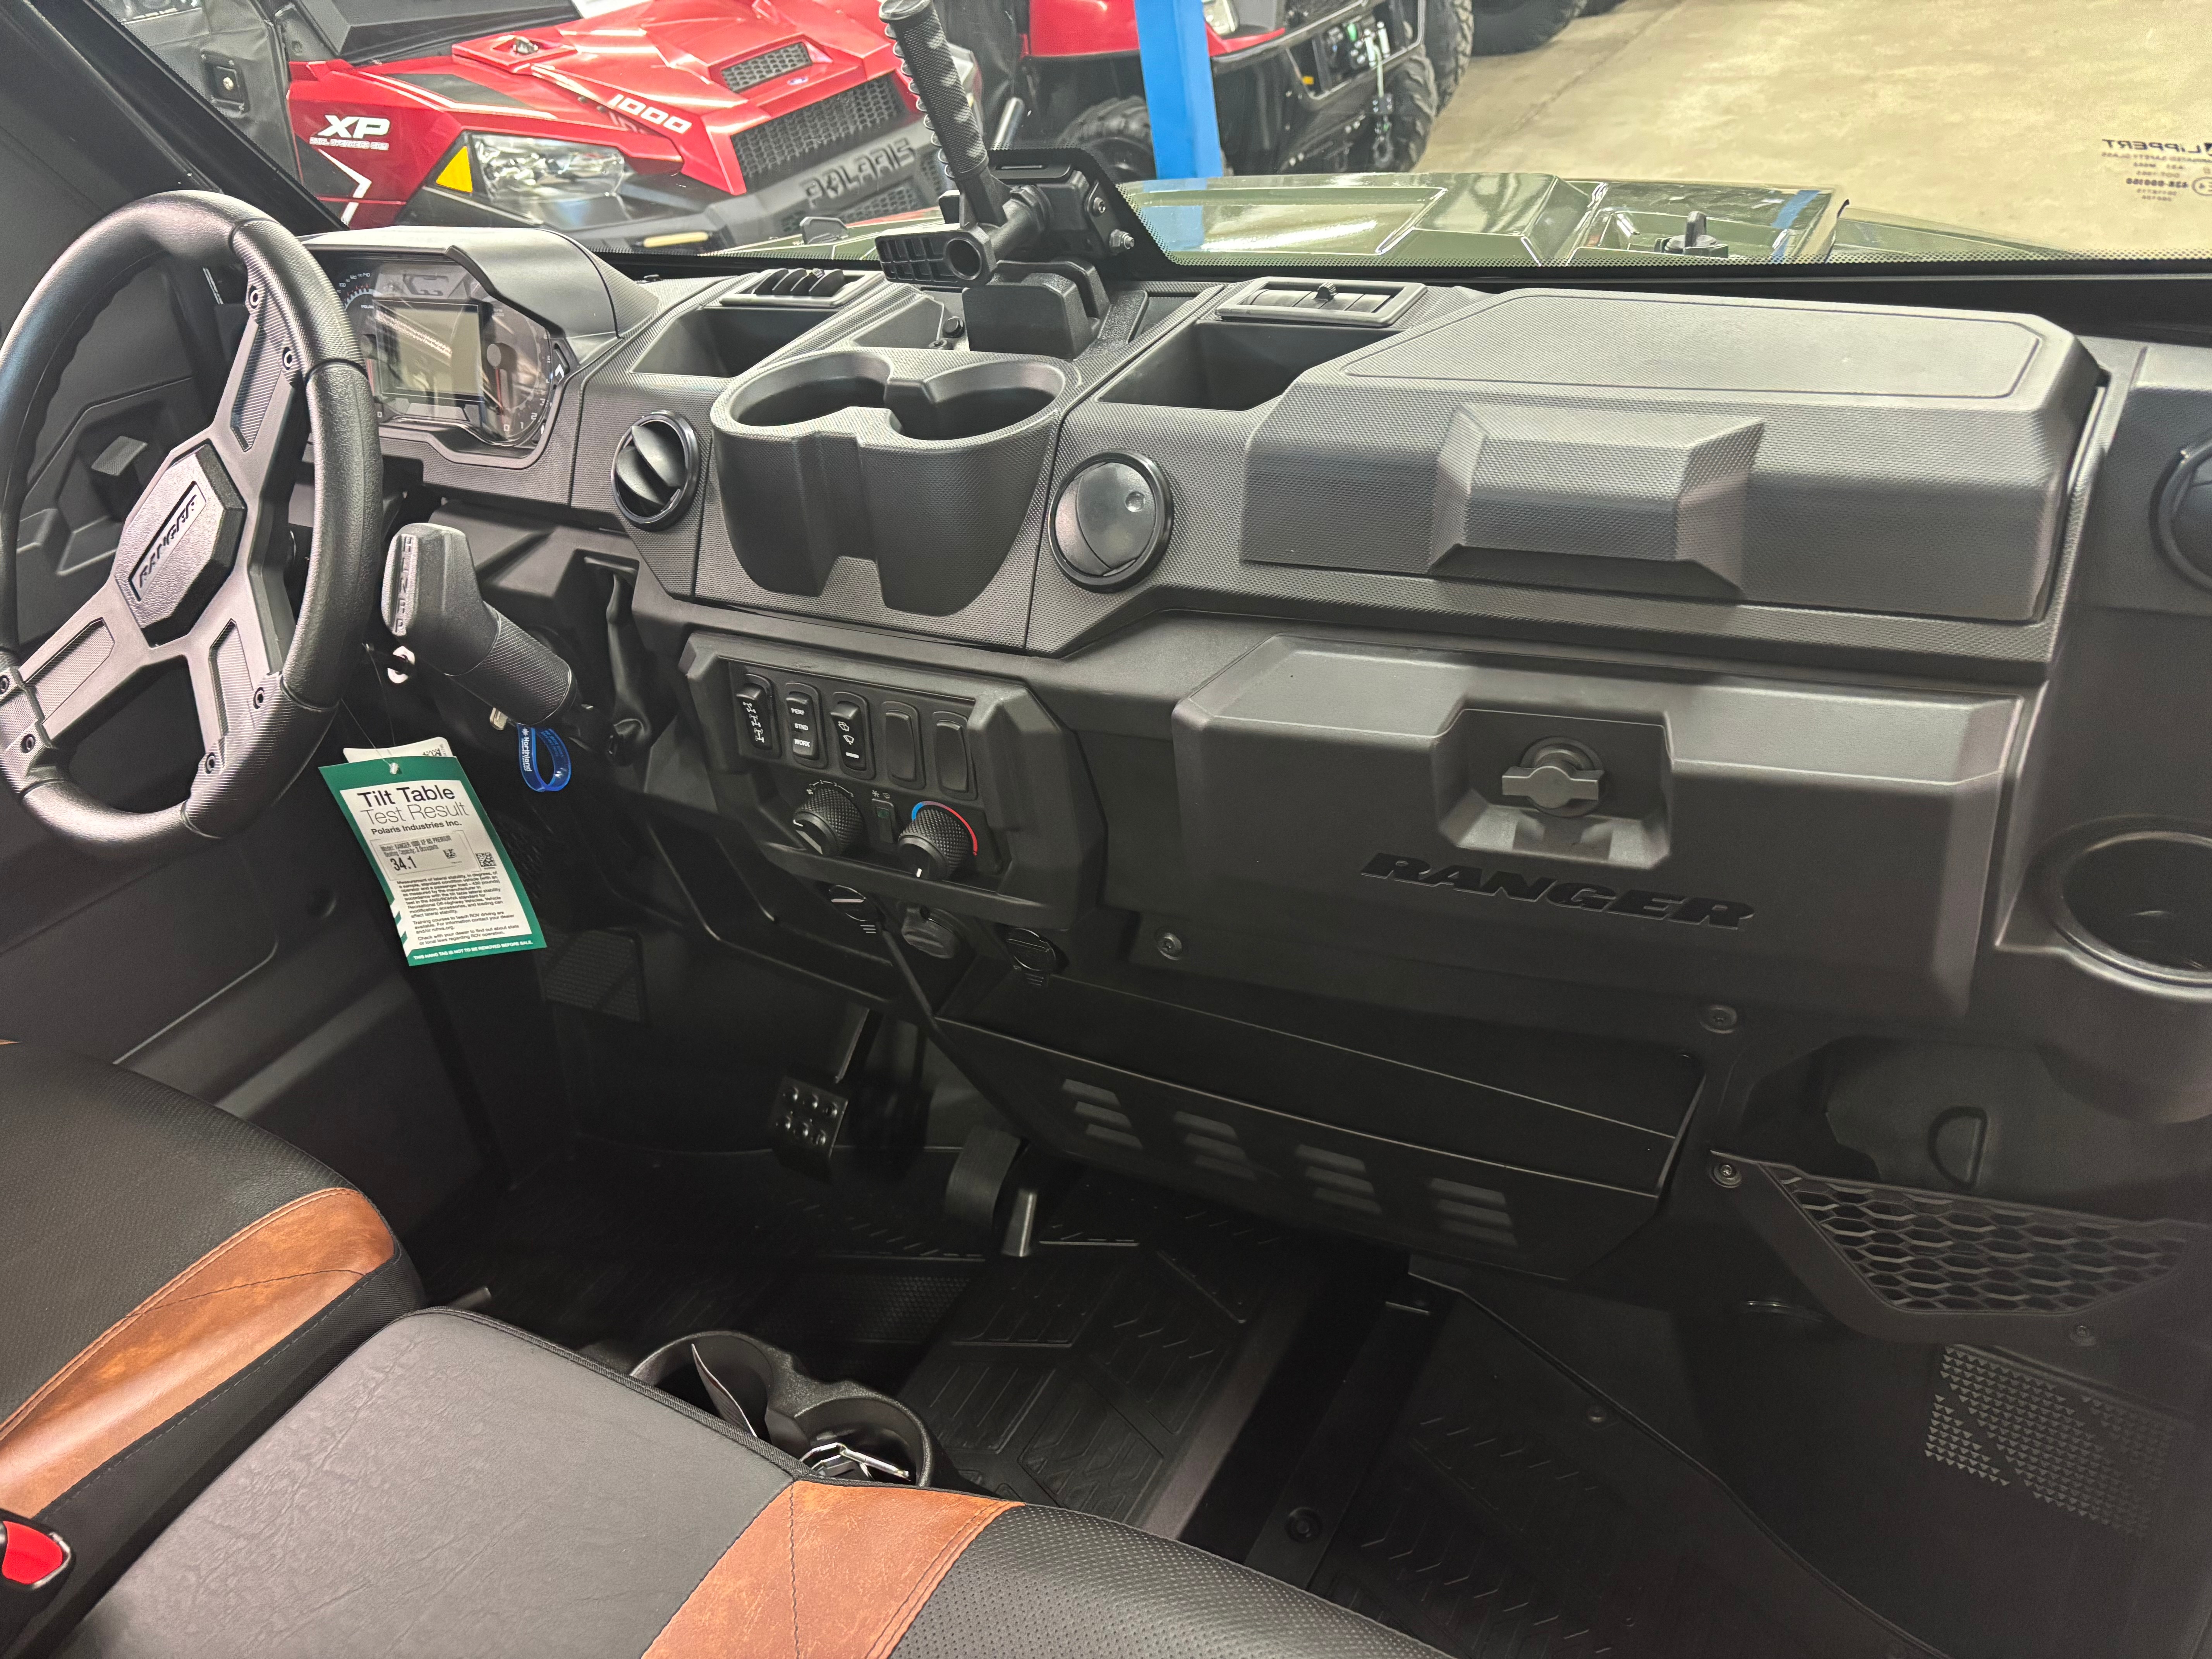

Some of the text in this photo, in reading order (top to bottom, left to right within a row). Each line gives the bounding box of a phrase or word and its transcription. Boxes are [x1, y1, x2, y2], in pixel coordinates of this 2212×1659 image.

[608, 94, 692, 134] 1000
[318, 115, 390, 139] XP
[799, 137, 915, 209] POLARIS
[539, 398, 546, 406] 3
[503, 424, 510, 432] 0
[139, 494, 197, 589] RANGER
[794, 738, 810, 747] WORK
[524, 737, 533, 772] Northland
[357, 785, 455, 807] Tilt Table
[361, 802, 469, 824] Test Result
[402, 822, 445, 831] Industries
[390, 856, 417, 871] 34.1
[1360, 852, 1755, 929] RANGER
